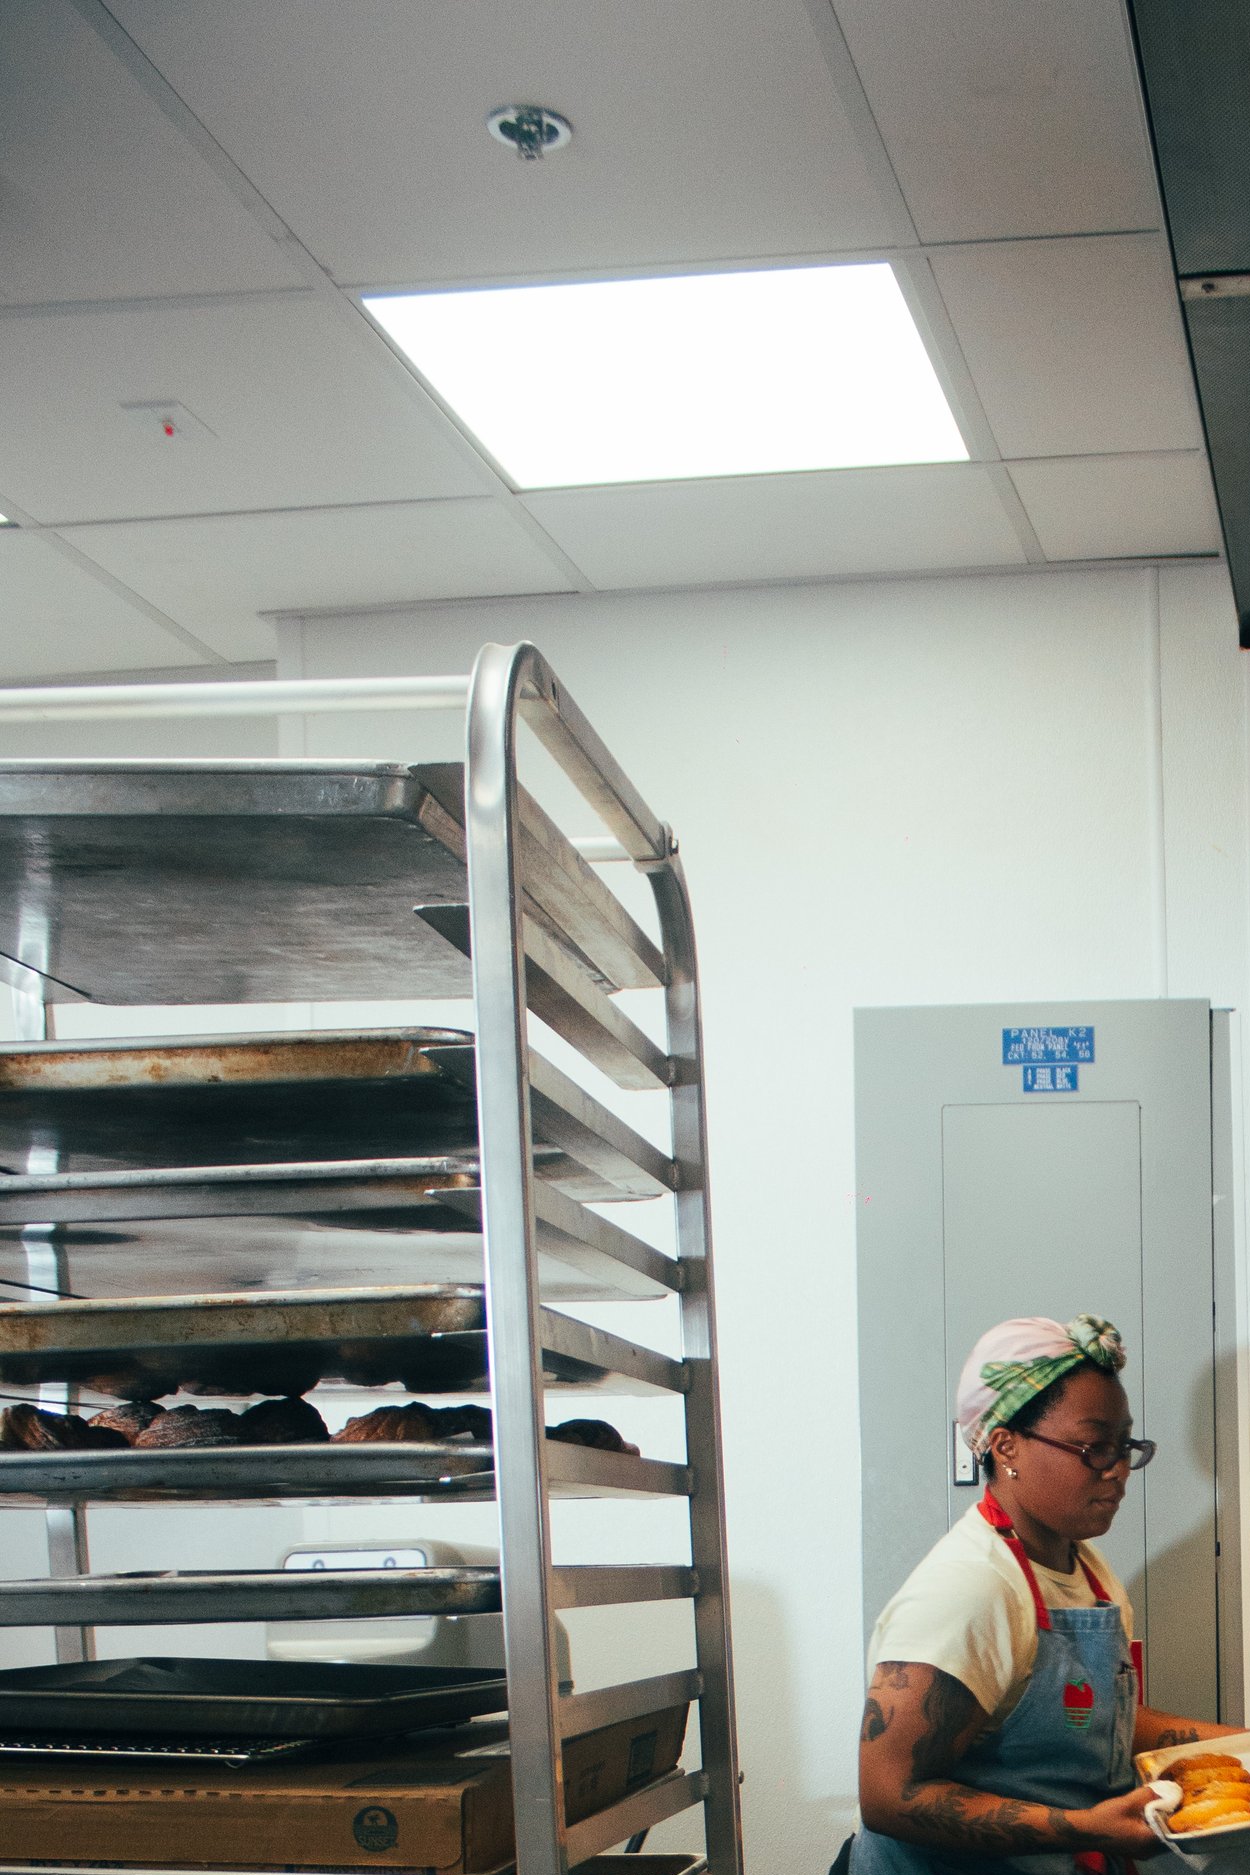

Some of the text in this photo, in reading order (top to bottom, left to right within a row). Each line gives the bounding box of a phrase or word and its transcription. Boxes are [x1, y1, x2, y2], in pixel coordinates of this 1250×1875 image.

[1011, 1027, 1087, 1038] PANEL K2
[1011, 1043, 1024, 1052] FED
